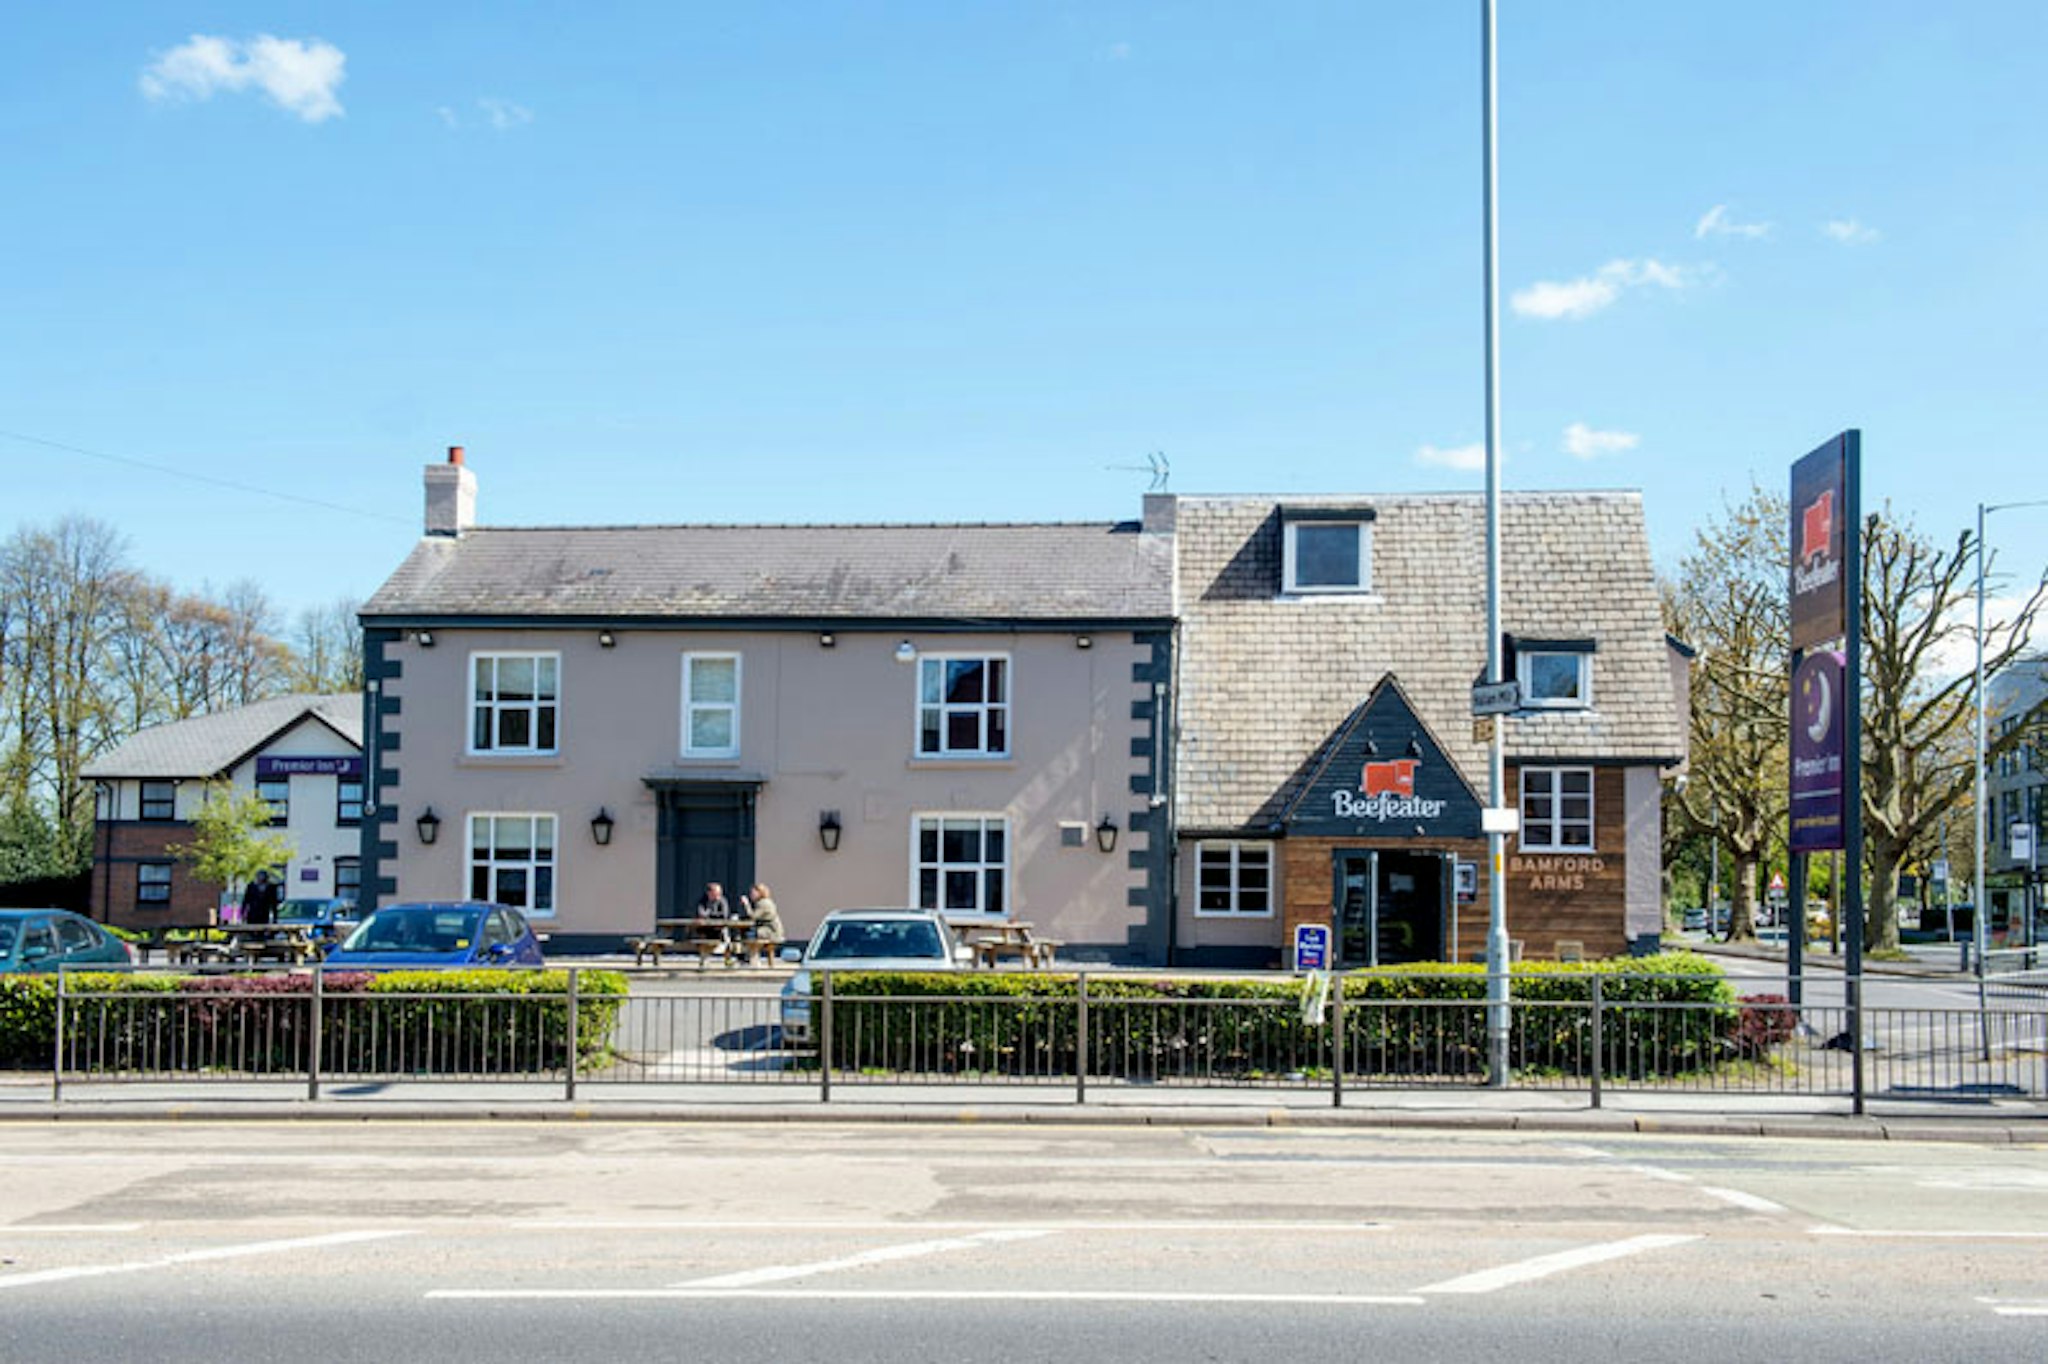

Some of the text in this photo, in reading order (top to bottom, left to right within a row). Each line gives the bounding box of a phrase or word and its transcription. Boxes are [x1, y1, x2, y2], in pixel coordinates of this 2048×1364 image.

[271, 759, 336, 772] Premier Inn
[1794, 755, 1827, 777] Premier
[1331, 789, 1447, 823] Beefeater
[1510, 857, 1605, 872] BAMFORD
[1530, 875, 1585, 890] ARMS
